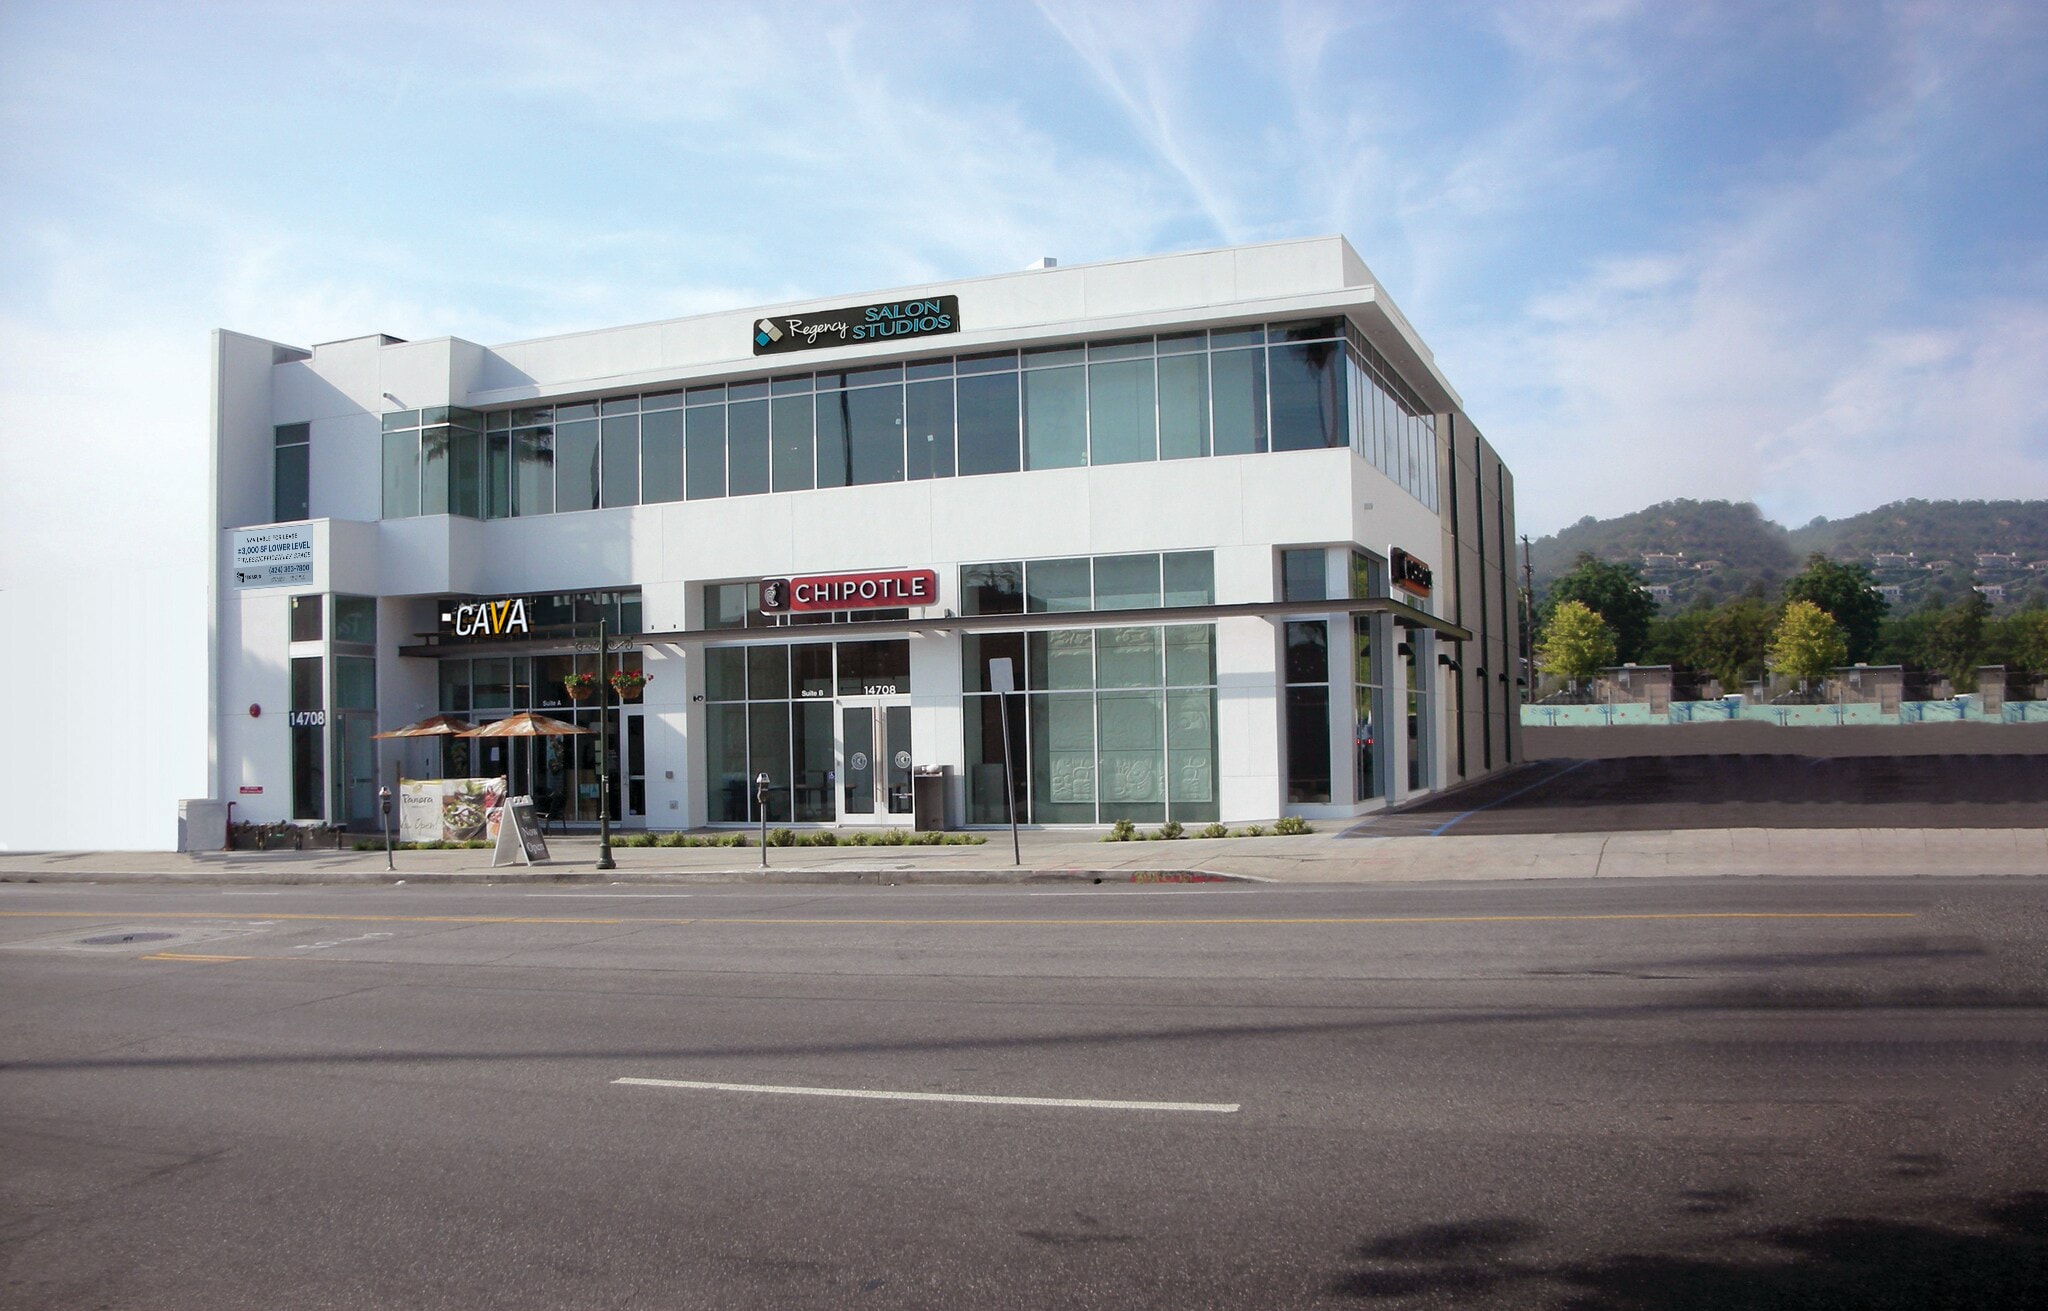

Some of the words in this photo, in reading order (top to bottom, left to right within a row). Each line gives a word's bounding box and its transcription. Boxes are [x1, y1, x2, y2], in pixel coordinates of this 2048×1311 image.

[865, 300, 941, 322] SALON
[785, 319, 850, 344] Regency
[852, 314, 951, 340] STUDIOS
[260, 545, 268, 553] SF
[268, 543, 291, 552] LOWER
[291, 541, 311, 550] LEVEL
[795, 577, 925, 603] CHIPOTLE
[456, 598, 528, 636] CAVA
[864, 685, 896, 695] 14708
[290, 711, 325, 726] 14708
[526, 842, 545, 854] Open
